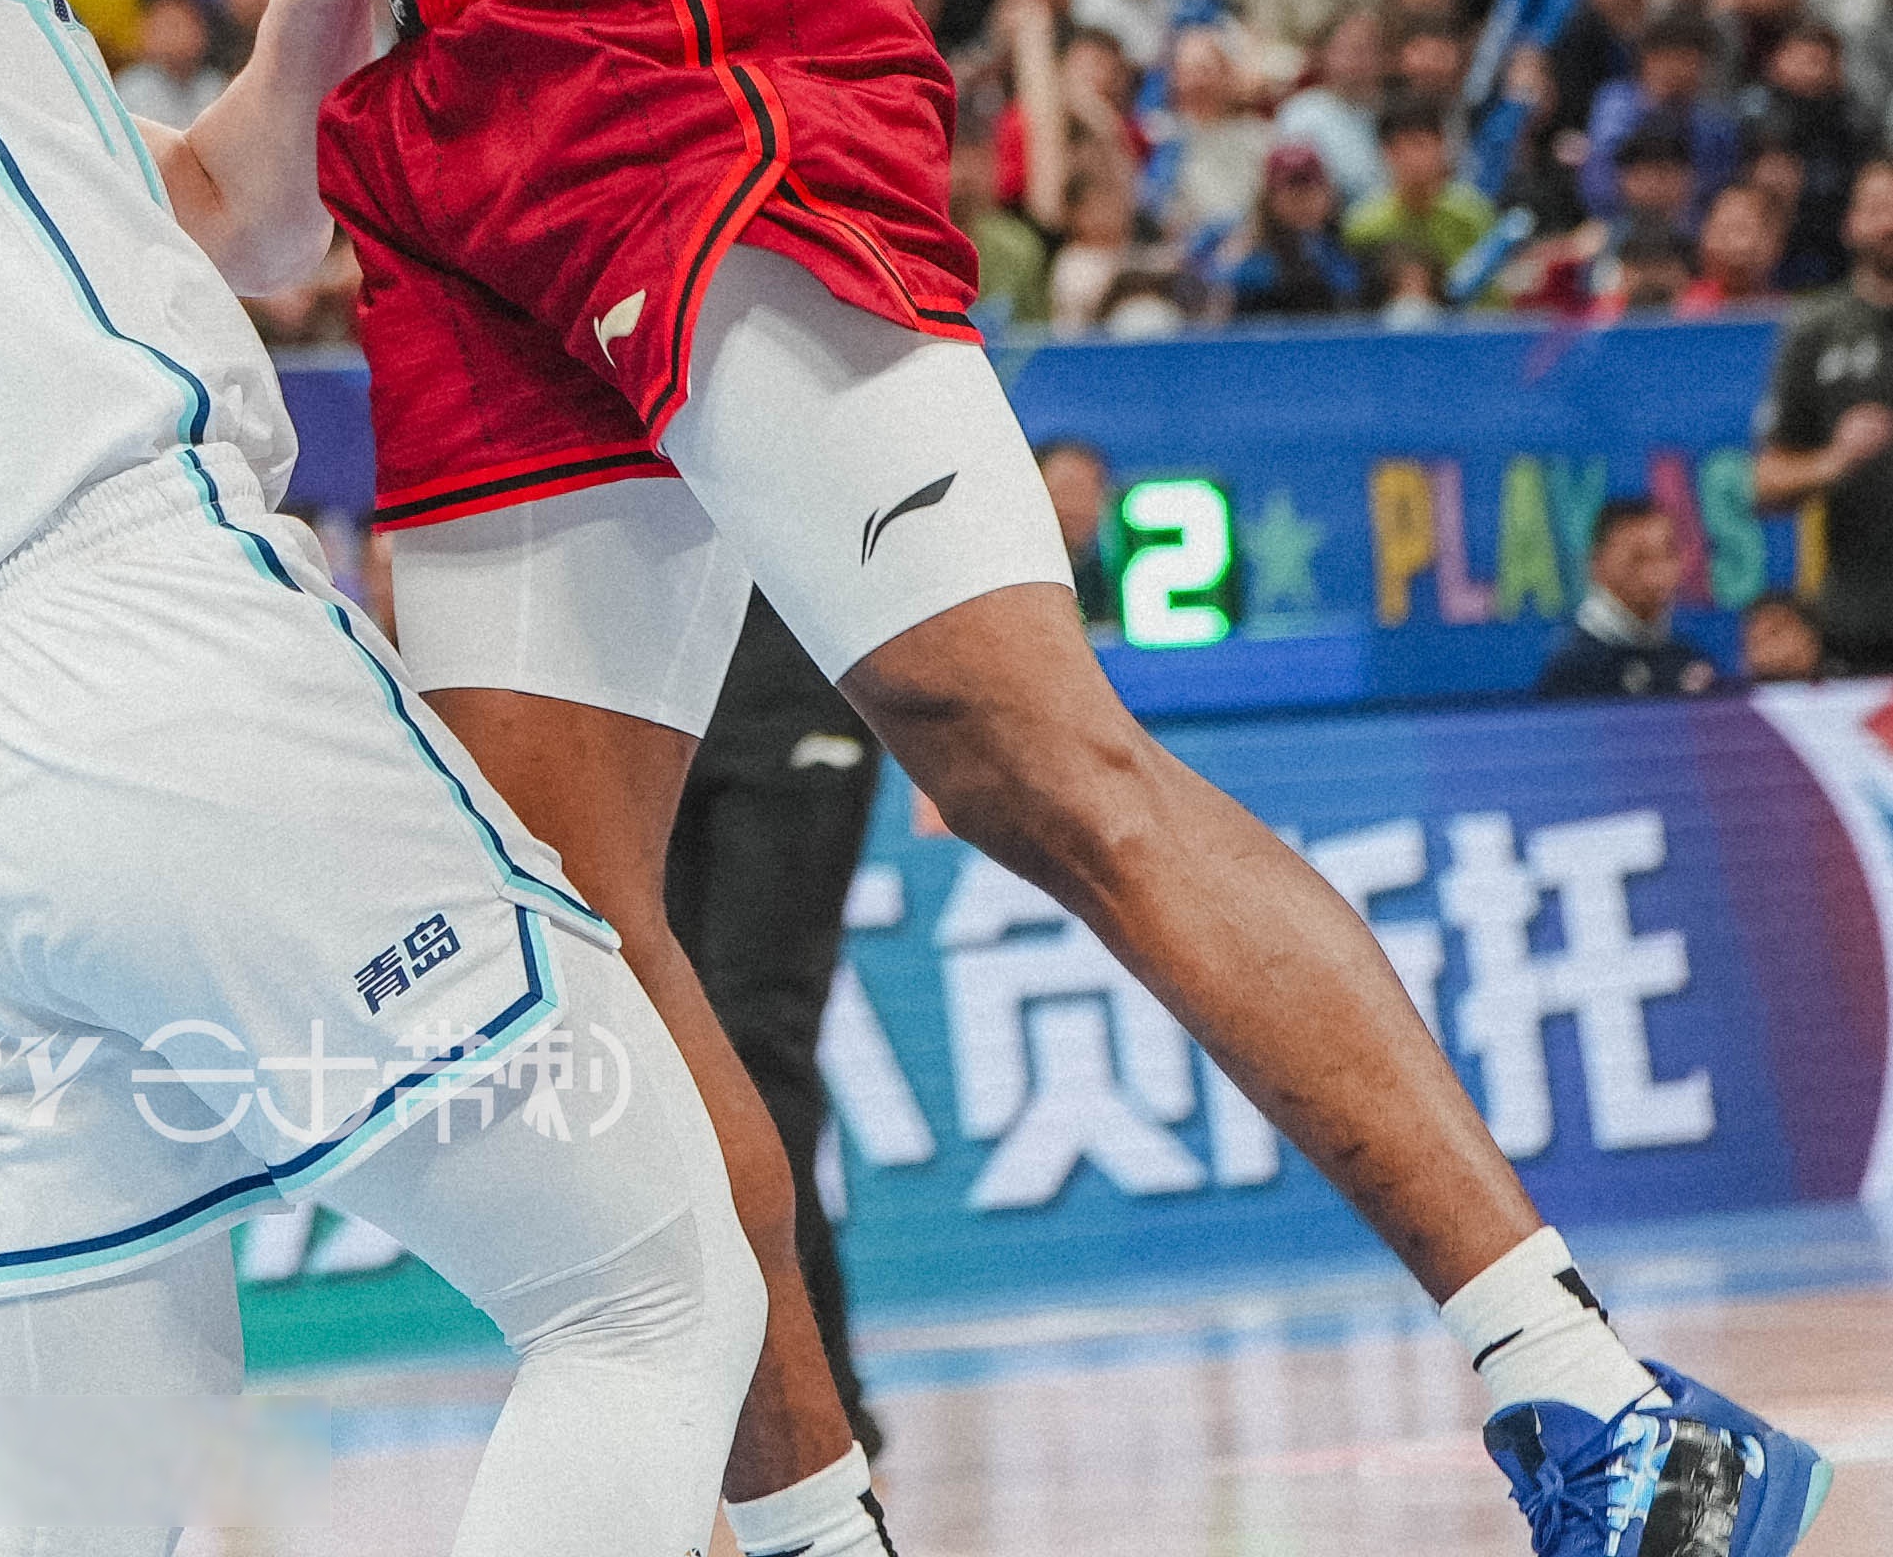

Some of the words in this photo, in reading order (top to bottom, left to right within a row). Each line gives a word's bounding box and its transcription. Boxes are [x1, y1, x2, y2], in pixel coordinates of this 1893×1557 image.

[1120, 477, 1232, 649] 2
[1370, 453, 1606, 625] PLAY
[354, 912, 461, 1017] 青岛
